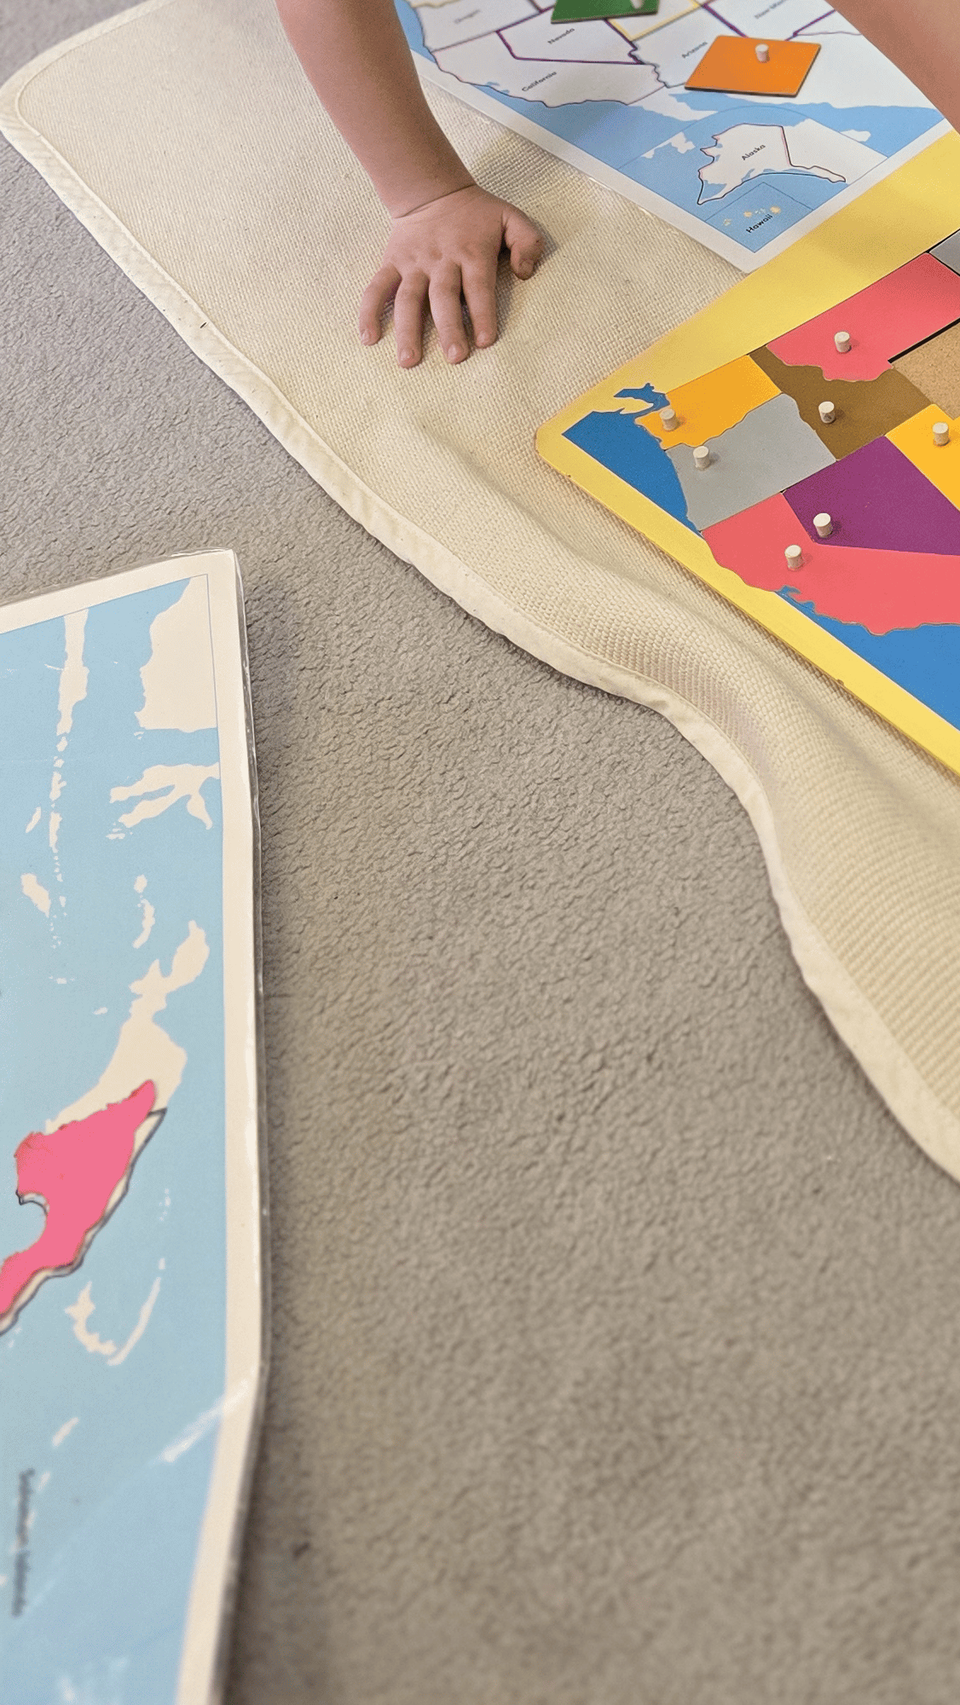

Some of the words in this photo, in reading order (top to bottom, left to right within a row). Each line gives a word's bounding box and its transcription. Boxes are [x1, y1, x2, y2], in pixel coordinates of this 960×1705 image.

[547, 27, 575, 45] Nevada
[682, 41, 708, 59] Arizona
[522, 71, 557, 92] California
[741, 144, 766, 161] Alaska
[746, 213, 773, 234] Hawaii
